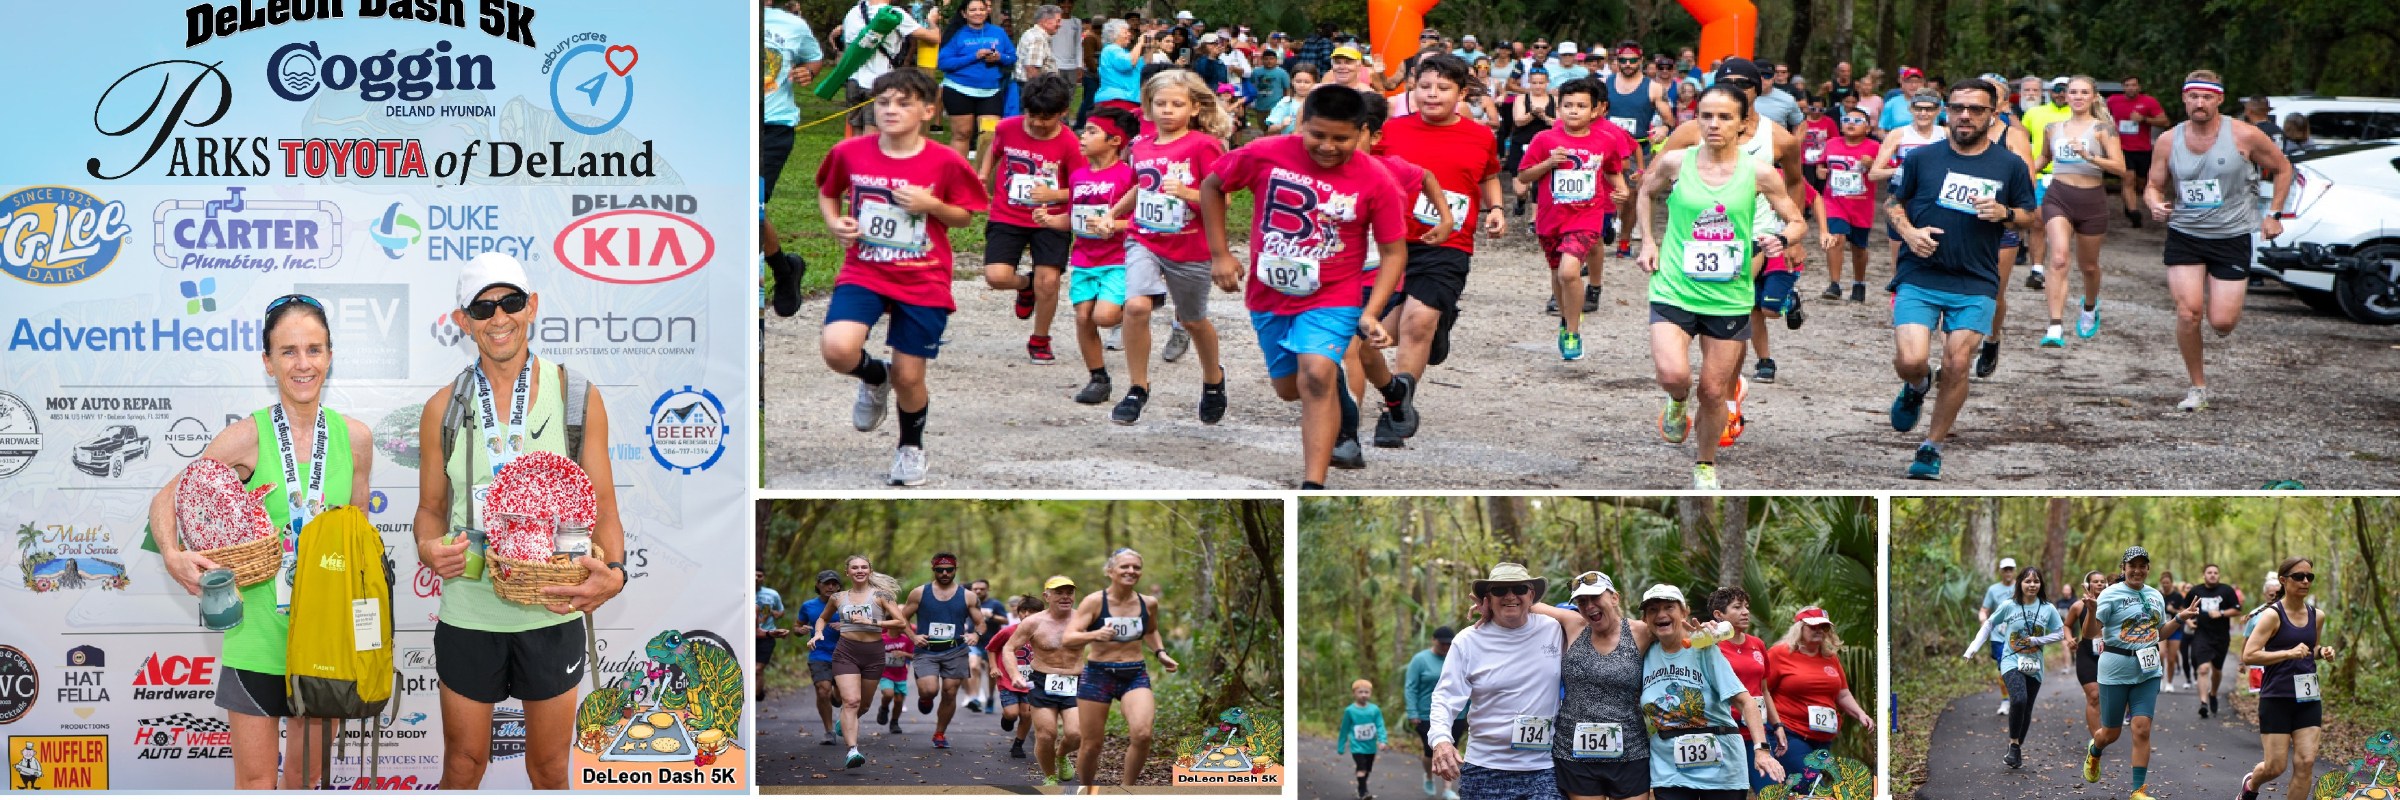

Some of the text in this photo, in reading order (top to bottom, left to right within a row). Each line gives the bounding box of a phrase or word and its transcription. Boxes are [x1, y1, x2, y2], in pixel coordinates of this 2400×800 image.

[186, 0, 344, 48] DeLeon
[480, 0, 536, 48] 5K
[541, 32, 607, 75] asbury cares
[266, 41, 497, 103] Coggin
[386, 105, 497, 118] DELAND HYUNDAI
[87, 59, 657, 186] PARKS TOYOTA of DeLand
[1557, 178, 1583, 193] 200
[13, 188, 92, 207] SINCE 1925
[2187, 188, 2206, 202] 35
[572, 194, 698, 216] DELAND
[1139, 202, 1164, 223] 105
[1260, 177, 1319, 243] B
[427, 205, 499, 231] DUKE
[870, 215, 898, 239] 89
[174, 218, 320, 250] CARTER
[427, 235, 536, 262] ENERGY
[582, 227, 688, 267] KIA
[282, 254, 318, 270] Inc.
[1695, 252, 1720, 272] 33
[28, 263, 87, 282] DAIRY
[1265, 267, 1299, 288] 192
[535, 311, 697, 344] arton
[554, 347, 573, 355] ELBIT
[575, 347, 608, 355] SYSTEMS
[610, 347, 621, 355] OF
[622, 347, 657, 355] AMERICA
[658, 347, 696, 355] COMPANY
[45, 397, 77, 411] MOY
[81, 397, 120, 411] AUTO
[123, 397, 172, 411] REPAIR
[511, 394, 526, 426] DeLeon
[164, 433, 213, 441] NISSAN
[657, 425, 717, 439] BEERY
[0, 437, 40, 446] ARDWARE
[616, 443, 645, 461] Vibe.
[309, 461, 323, 491] DeLeon
[42, 523, 111, 544] Matt's
[375, 523, 413, 533] SOLUTI
[57, 543, 119, 556] Pool Service
[933, 627, 945, 636] 51
[404, 649, 425, 667] The
[2020, 662, 2034, 672] 237
[2142, 654, 2156, 668] 152
[131, 651, 217, 687] ACE
[1669, 664, 1690, 679] Dash
[64, 671, 105, 686] HAT
[1051, 681, 1065, 691] 24
[57, 687, 111, 703] FELLA
[133, 687, 216, 701] Hardware
[2304, 682, 2312, 696] 3
[0, 701, 28, 719] ocktails
[60, 723, 111, 731] PRODUCTIONS
[1815, 713, 1828, 727] 62
[186, 731, 232, 747] WHEEL
[364, 730, 396, 739] ATO
[397, 730, 427, 739] BODY
[1519, 725, 1545, 744] 134
[1579, 733, 1608, 751] 154
[40, 740, 104, 763] MUFFLER
[138, 748, 183, 760] AUTO
[493, 743, 520, 751] UTO
[1679, 744, 1708, 763] 133
[333, 754, 440, 766] TTLE SRVICES INC
[53, 766, 92, 788] MAN
